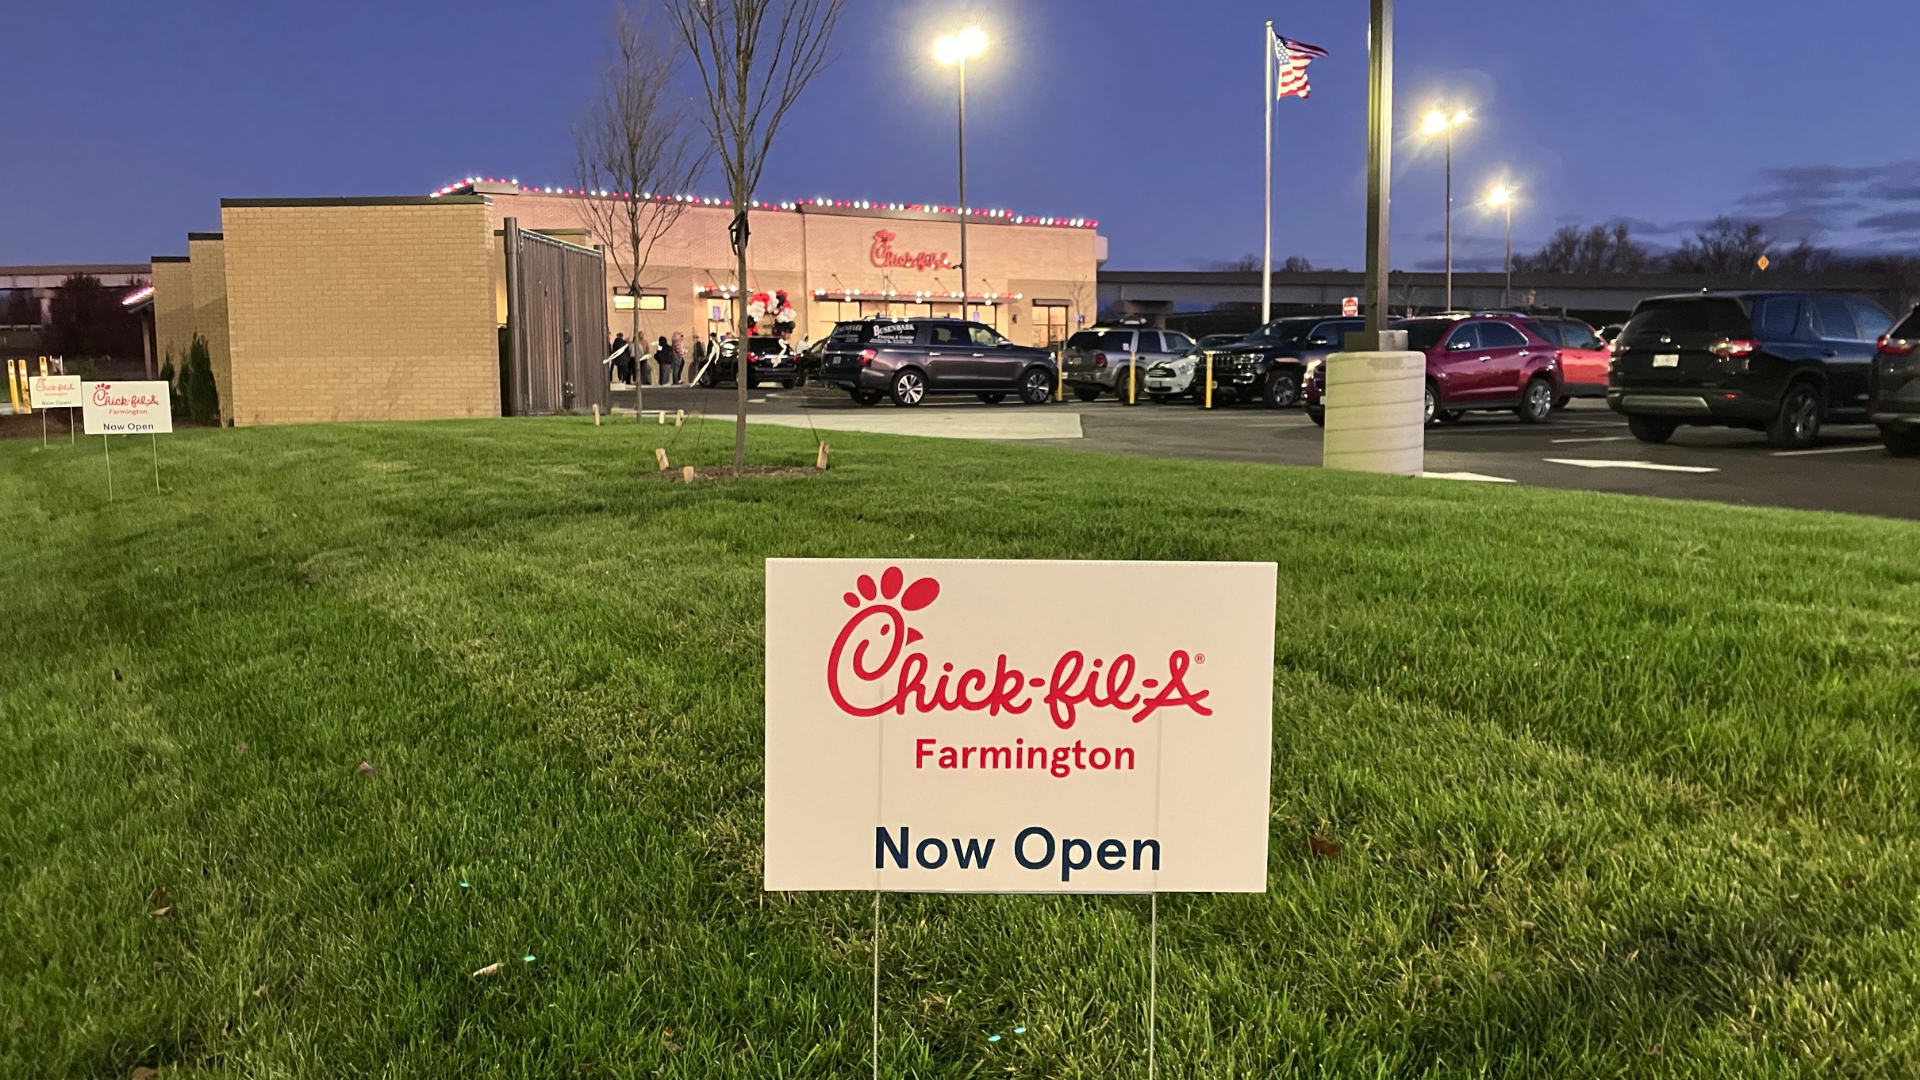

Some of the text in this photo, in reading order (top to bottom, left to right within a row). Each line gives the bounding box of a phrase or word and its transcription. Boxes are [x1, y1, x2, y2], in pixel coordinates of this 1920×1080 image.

[103, 423, 154, 432] Now Open
[915, 737, 1136, 779] Farmington
[875, 826, 1161, 882] Now Open
